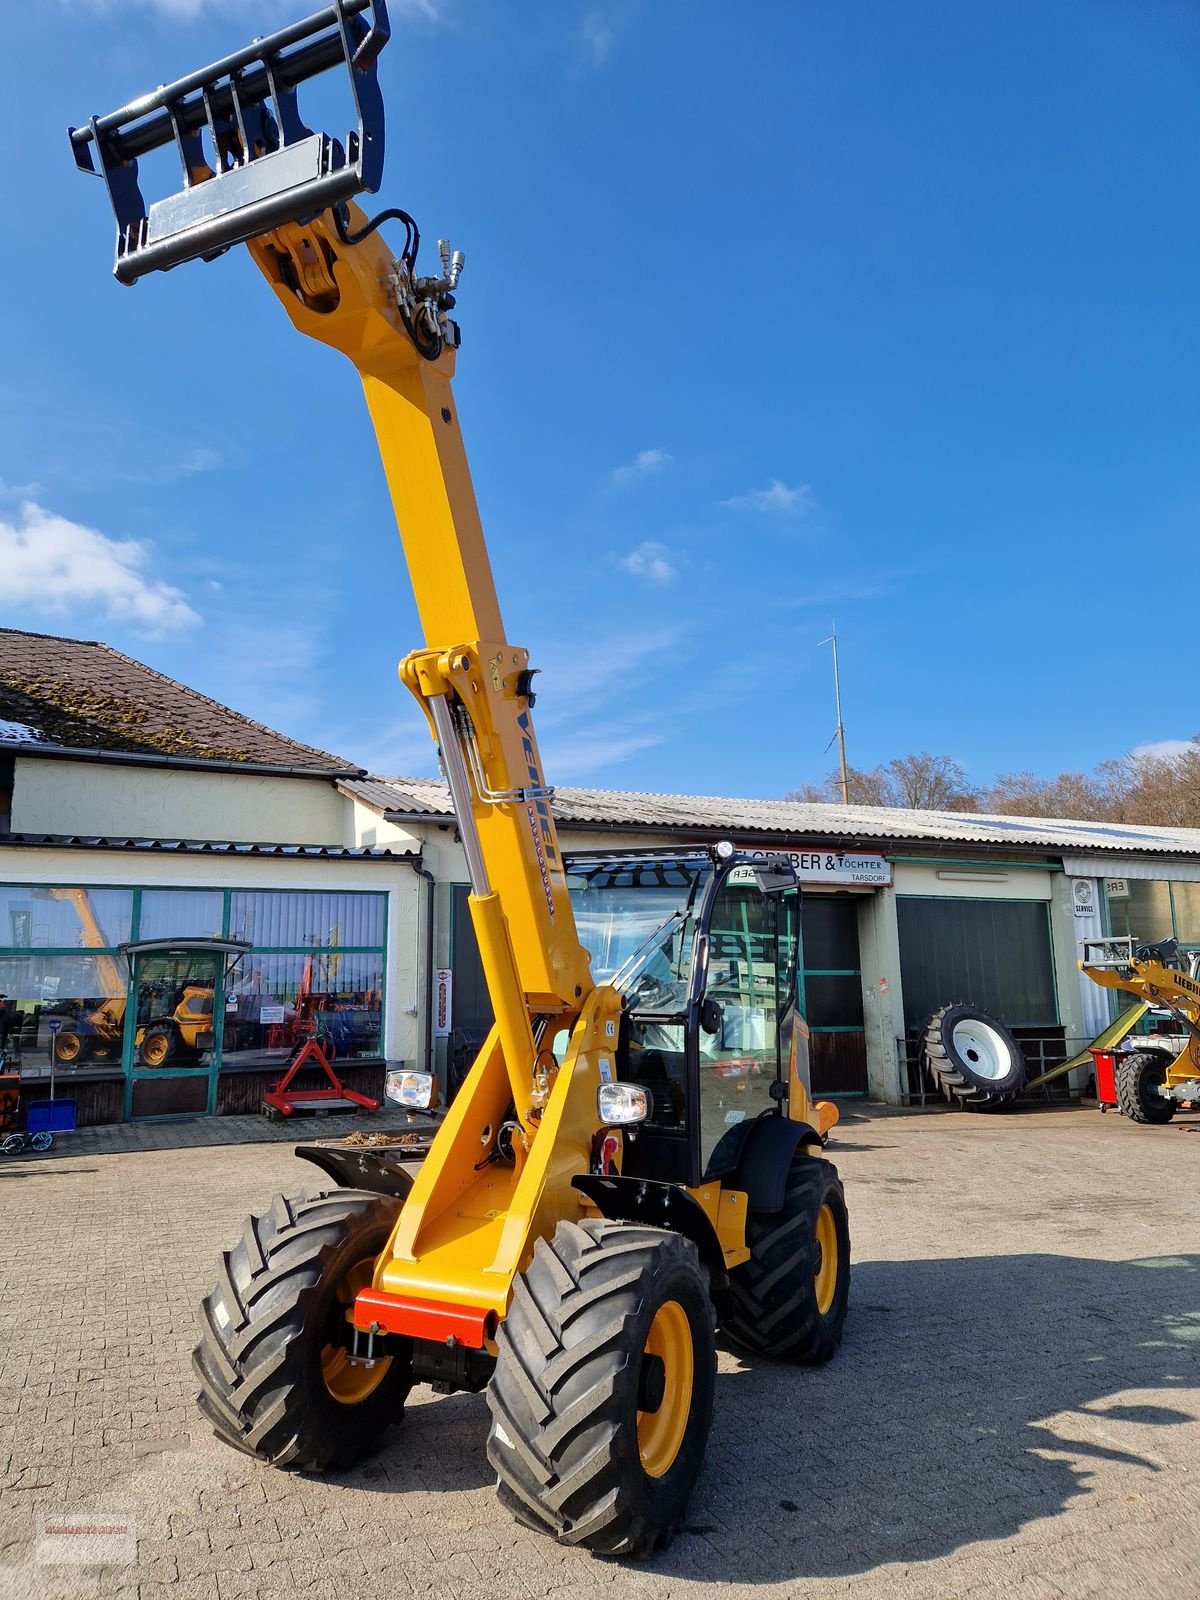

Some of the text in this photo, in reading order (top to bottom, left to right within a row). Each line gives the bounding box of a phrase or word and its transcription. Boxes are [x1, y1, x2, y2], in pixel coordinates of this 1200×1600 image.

[825, 857, 836, 870] &
[838, 858, 882, 869] TÖCHTER
[852, 874, 886, 882] TARSDORF
[1075, 905, 1094, 913] SERVICE
[1174, 974, 1200, 997] LIEBH
